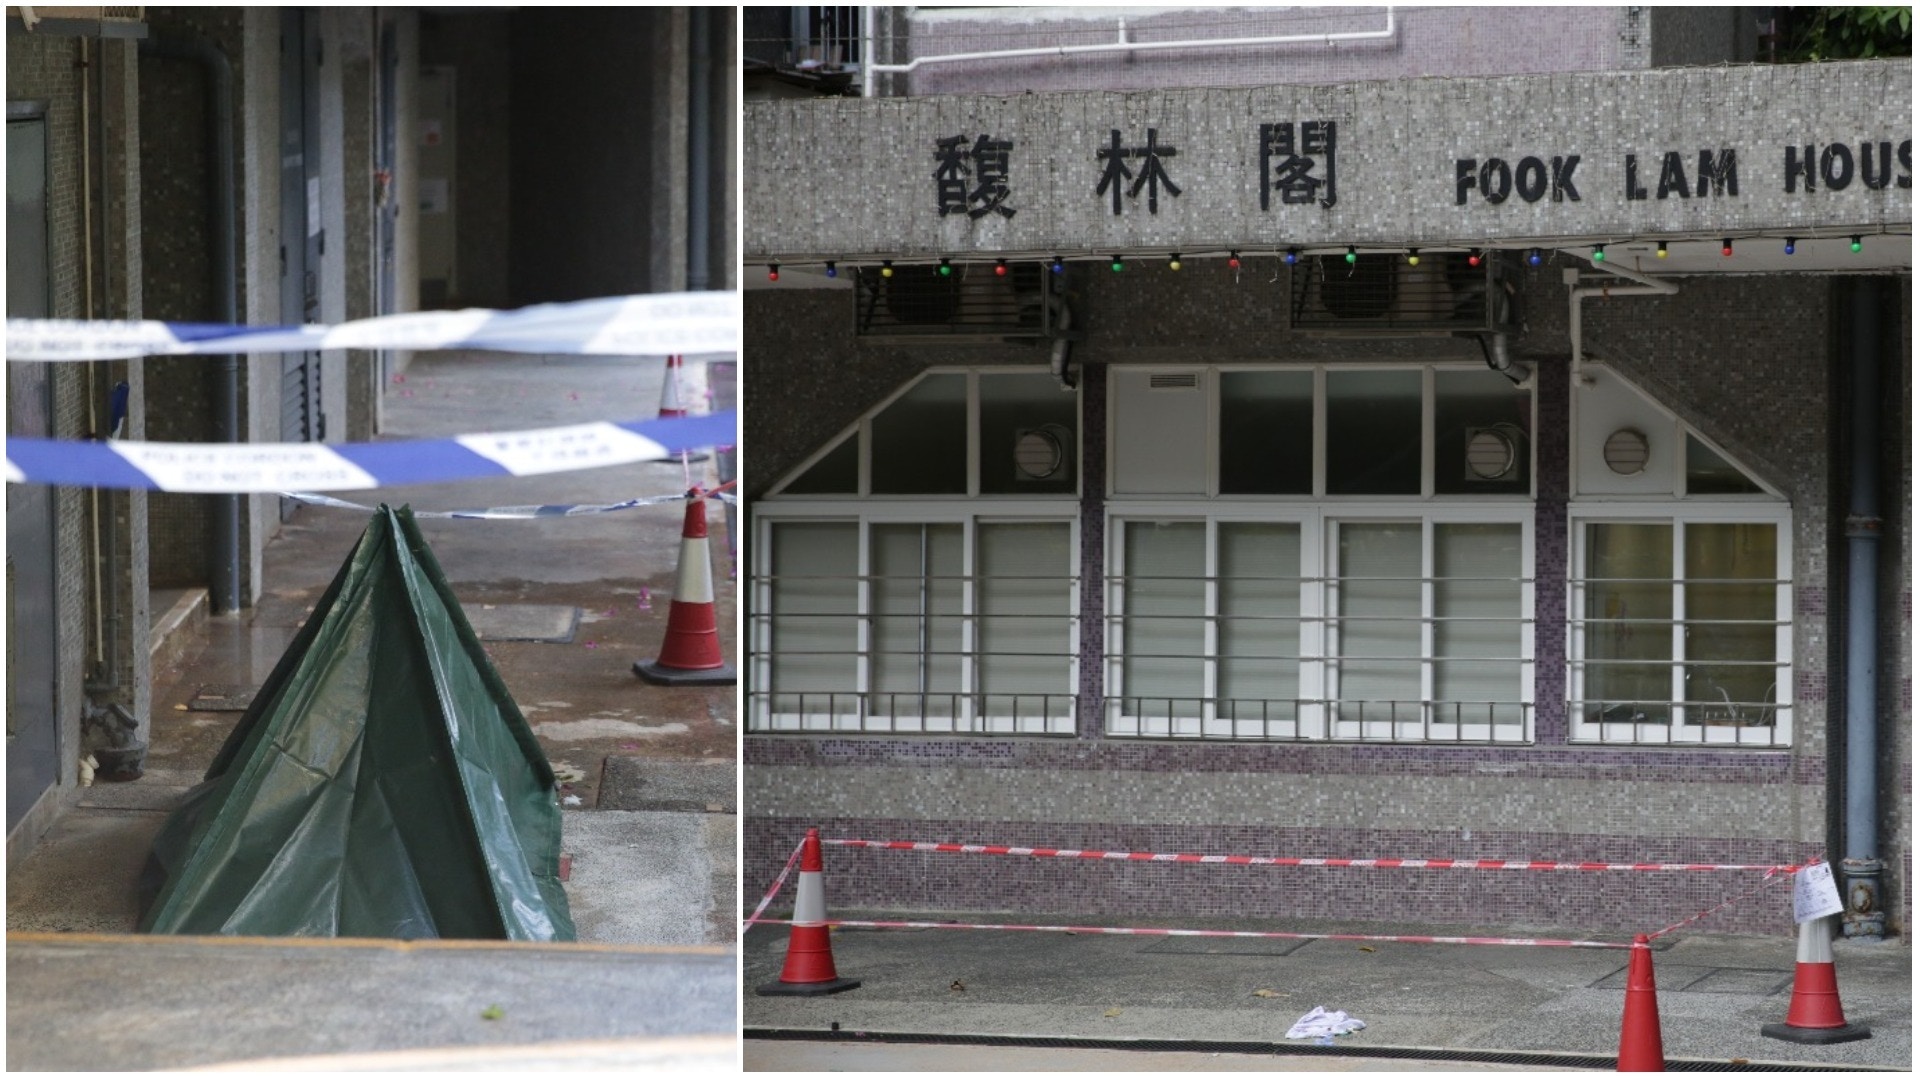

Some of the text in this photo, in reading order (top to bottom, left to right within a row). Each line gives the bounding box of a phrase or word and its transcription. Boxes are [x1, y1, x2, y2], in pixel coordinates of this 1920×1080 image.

[933, 121, 1336, 221] 馥林閣
[1457, 156, 1580, 205] FOOK
[1627, 149, 1738, 200] LAM
